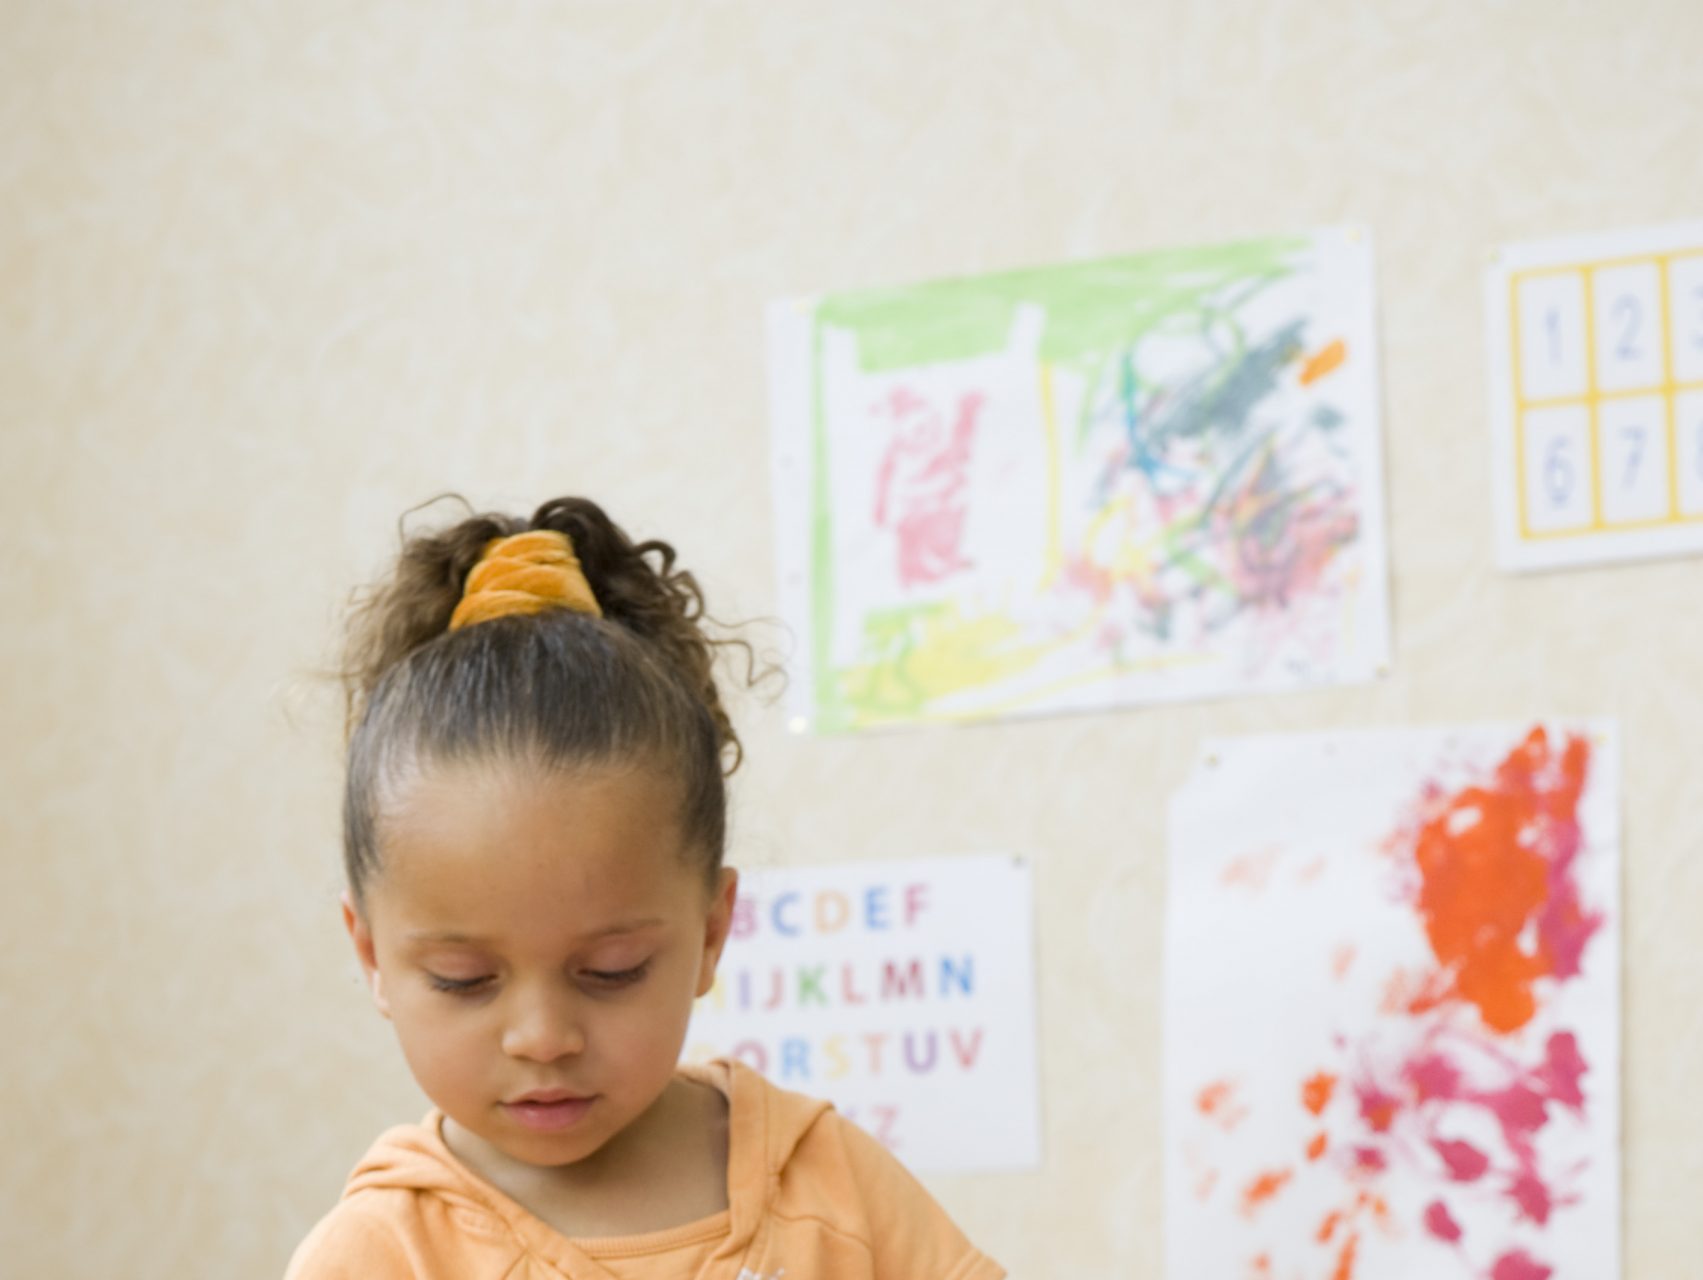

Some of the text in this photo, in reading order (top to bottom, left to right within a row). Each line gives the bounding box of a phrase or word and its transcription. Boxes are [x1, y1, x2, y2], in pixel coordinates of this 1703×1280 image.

[1611, 292, 1643, 361] 2
[1543, 434, 1577, 508] 6
[1618, 426, 1648, 488] 7
